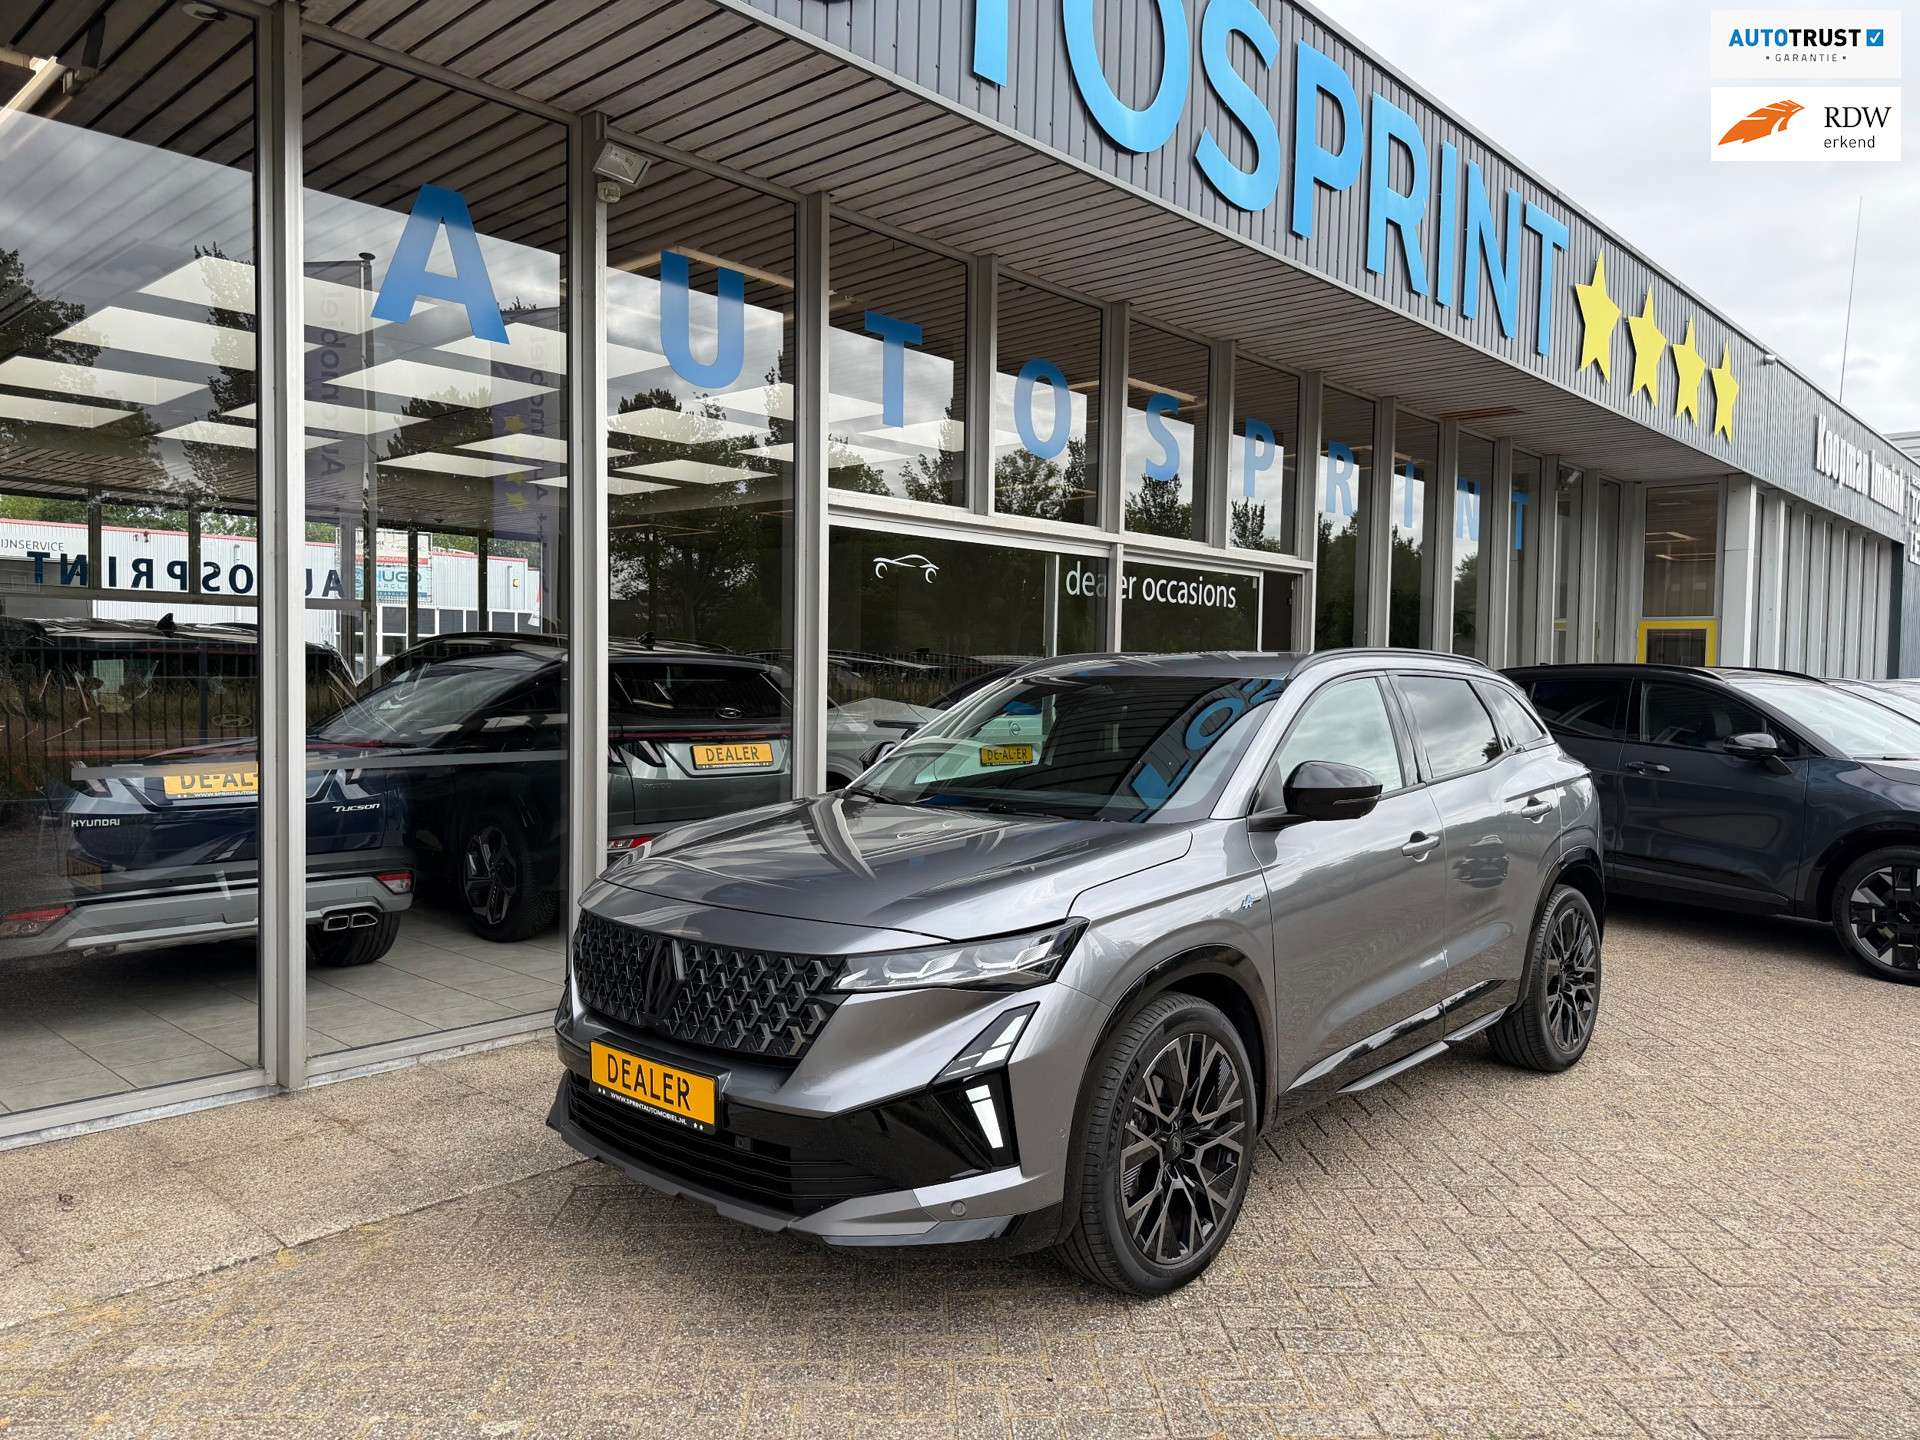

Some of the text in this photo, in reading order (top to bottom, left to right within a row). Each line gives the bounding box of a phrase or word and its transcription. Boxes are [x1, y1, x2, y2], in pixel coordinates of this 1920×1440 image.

[1066, 561, 1237, 609] deaer occasions
[706, 746, 760, 762] DEALER
[71, 819, 120, 828] HYUNDAI
[607, 1053, 691, 1111] DEALER
